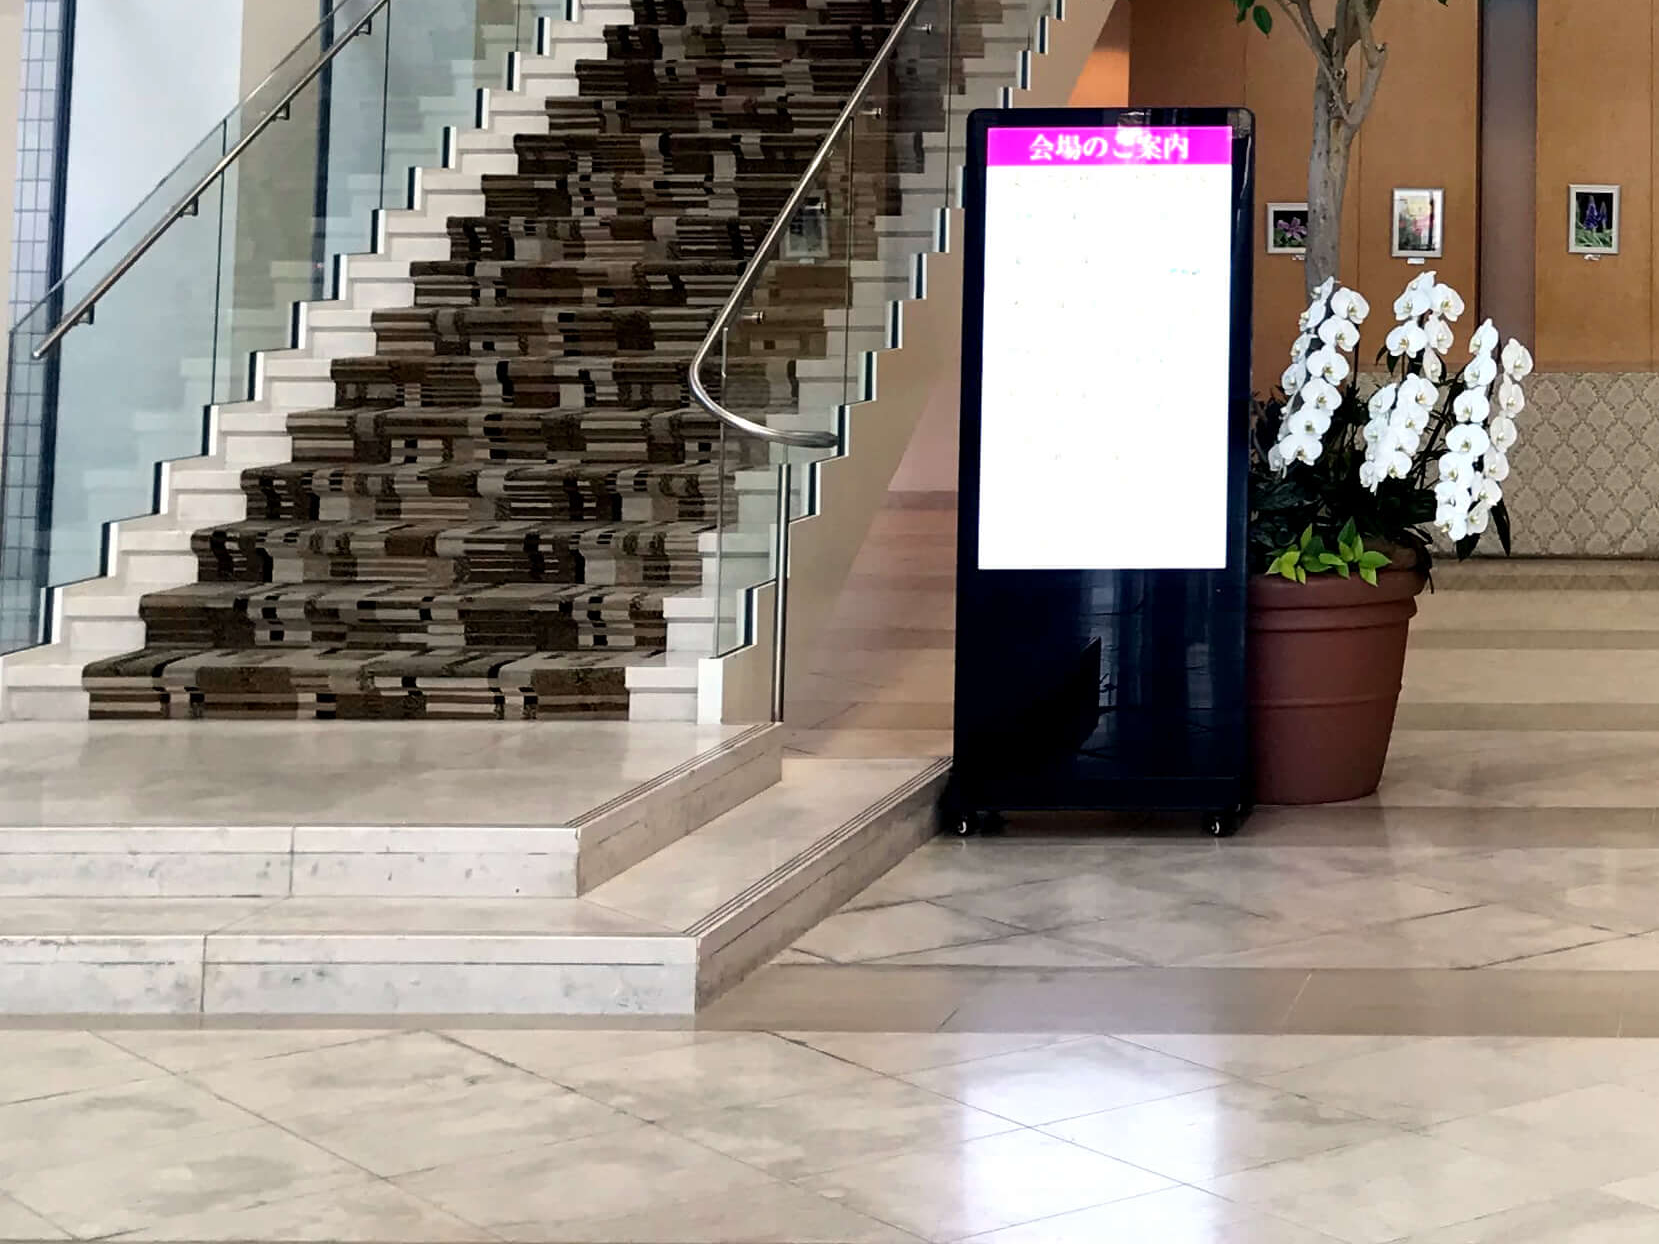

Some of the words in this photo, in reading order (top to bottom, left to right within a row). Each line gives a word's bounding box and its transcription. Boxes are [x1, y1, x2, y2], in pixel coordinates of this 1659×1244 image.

[1029, 132, 1189, 161] 会場のご案内
